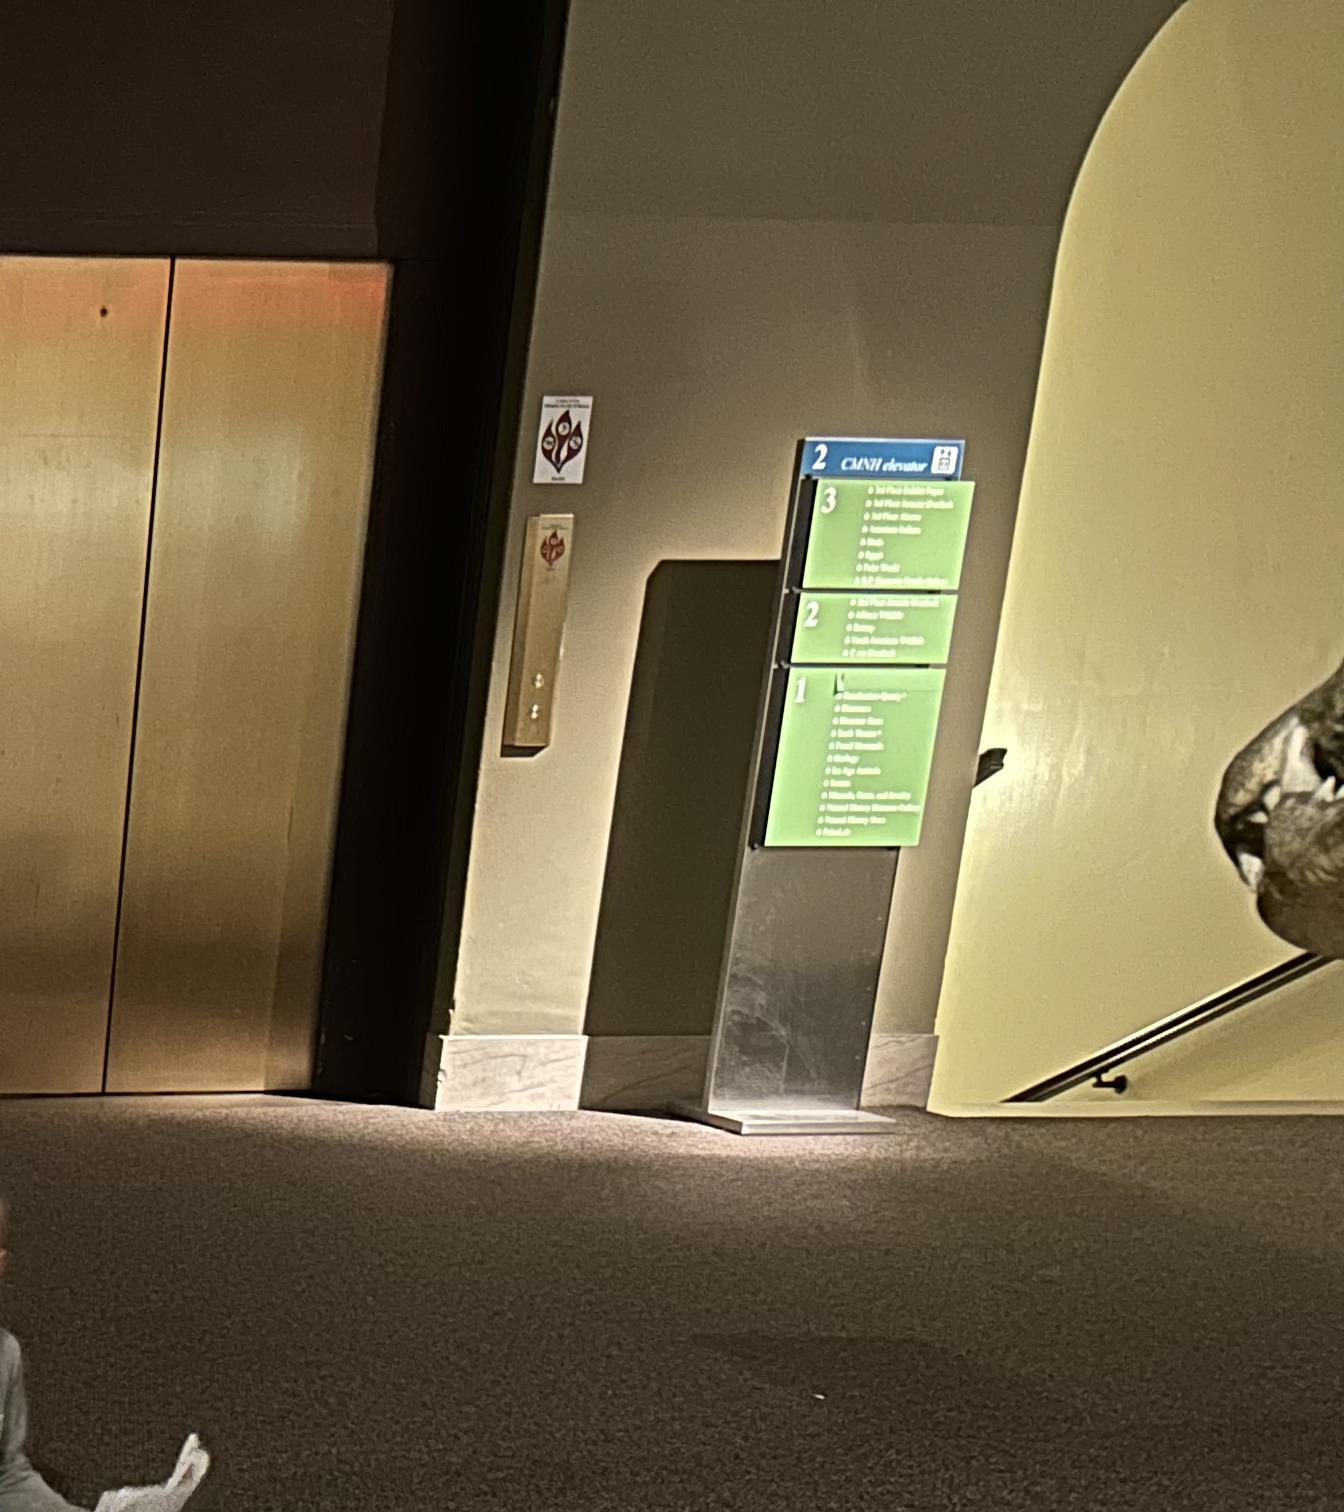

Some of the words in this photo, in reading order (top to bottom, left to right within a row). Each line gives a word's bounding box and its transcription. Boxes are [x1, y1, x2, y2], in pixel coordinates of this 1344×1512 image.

[812, 444, 828, 470] 2
[841, 457, 882, 472] CMNH
[882, 458, 929, 472] elevator
[820, 487, 837, 514] 3
[803, 601, 819, 628] 2
[794, 676, 808, 703] 1
